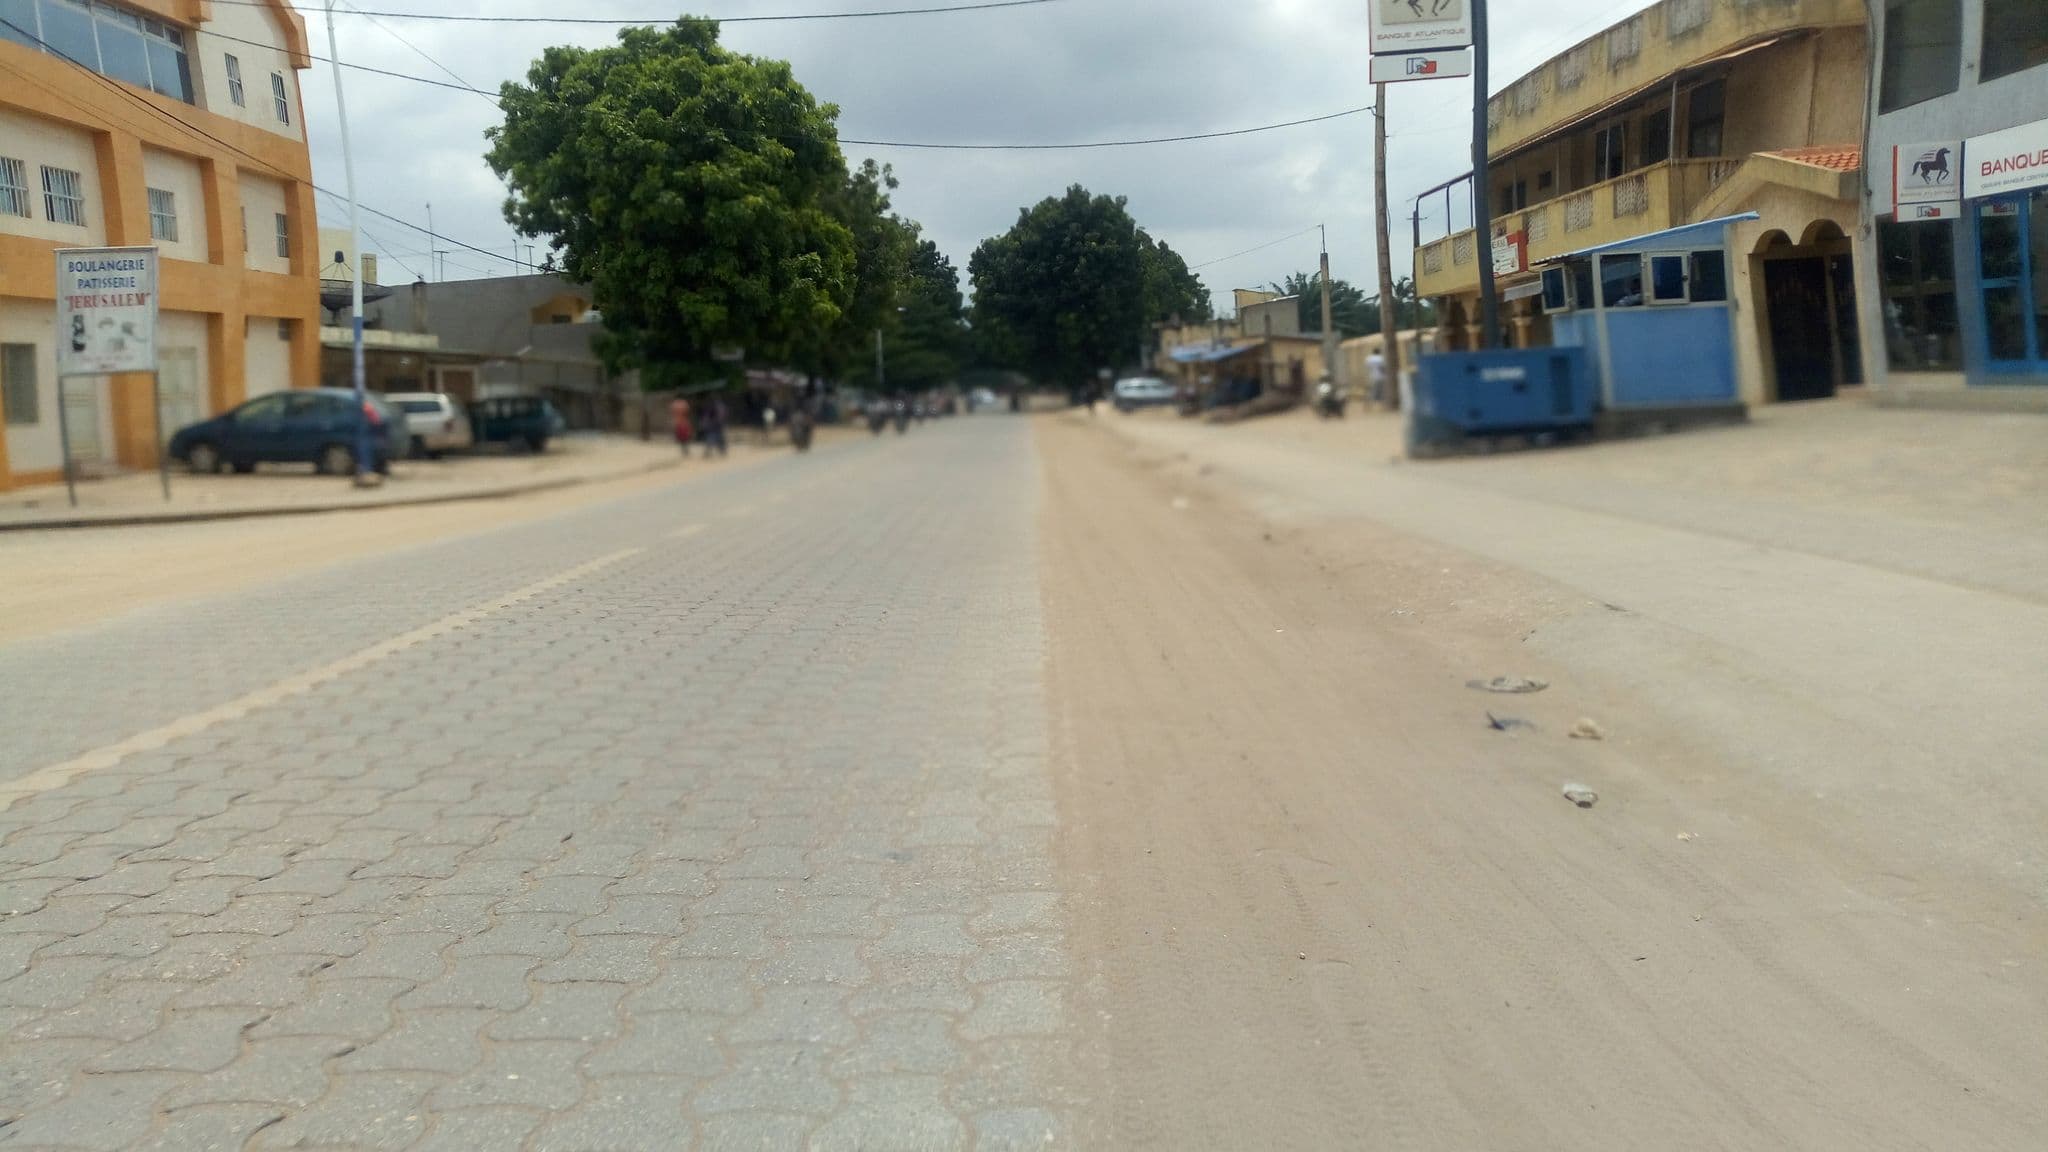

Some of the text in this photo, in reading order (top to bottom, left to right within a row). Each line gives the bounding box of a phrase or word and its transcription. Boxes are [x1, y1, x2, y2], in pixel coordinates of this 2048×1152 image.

[1377, 32, 1412, 40] BANQUE
[1414, 28, 1466, 37] ATLANTIQUE
[1981, 149, 2048, 177] BANQUE
[68, 259, 145, 273] BOULANGERIE
[77, 276, 136, 289] PATISSERIE
